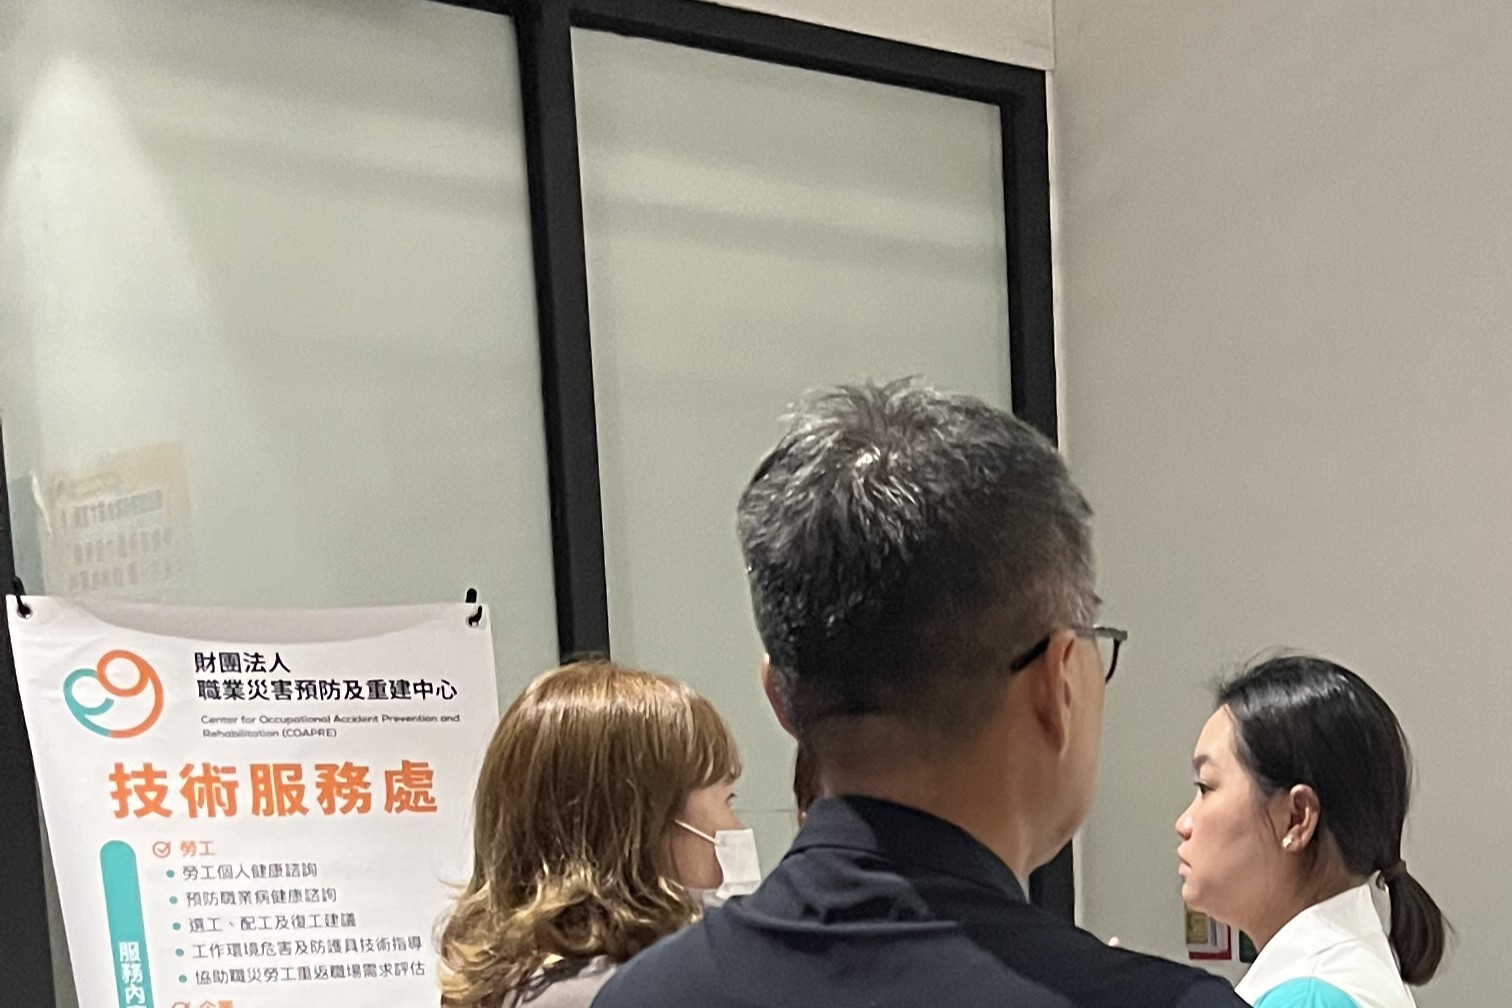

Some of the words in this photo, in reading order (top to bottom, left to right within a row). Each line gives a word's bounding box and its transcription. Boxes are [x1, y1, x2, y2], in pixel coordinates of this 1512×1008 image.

[195, 652, 291, 675] 財團法人
[197, 679, 459, 702] 職業災害預防及重建中心
[201, 715, 238, 725] Center
[241, 715, 256, 725] for
[259, 714, 331, 726] Occupational
[333, 714, 379, 724] Accident
[382, 714, 438, 724] Prevention
[441, 714, 461, 724] and
[203, 728, 279, 738] Rehabilitation
[282, 727, 338, 739] (COAPRE)
[109, 759, 438, 819] 技術服務處
[180, 841, 216, 858] 勞工
[183, 862, 318, 881] 勞工個人健康諮詢
[186, 887, 337, 908] 預防職業病健康諮詢
[192, 935, 423, 960] 工作環境危害及防護具技術指導
[195, 961, 426, 986] 協助職災勞工重返職場需求評估
